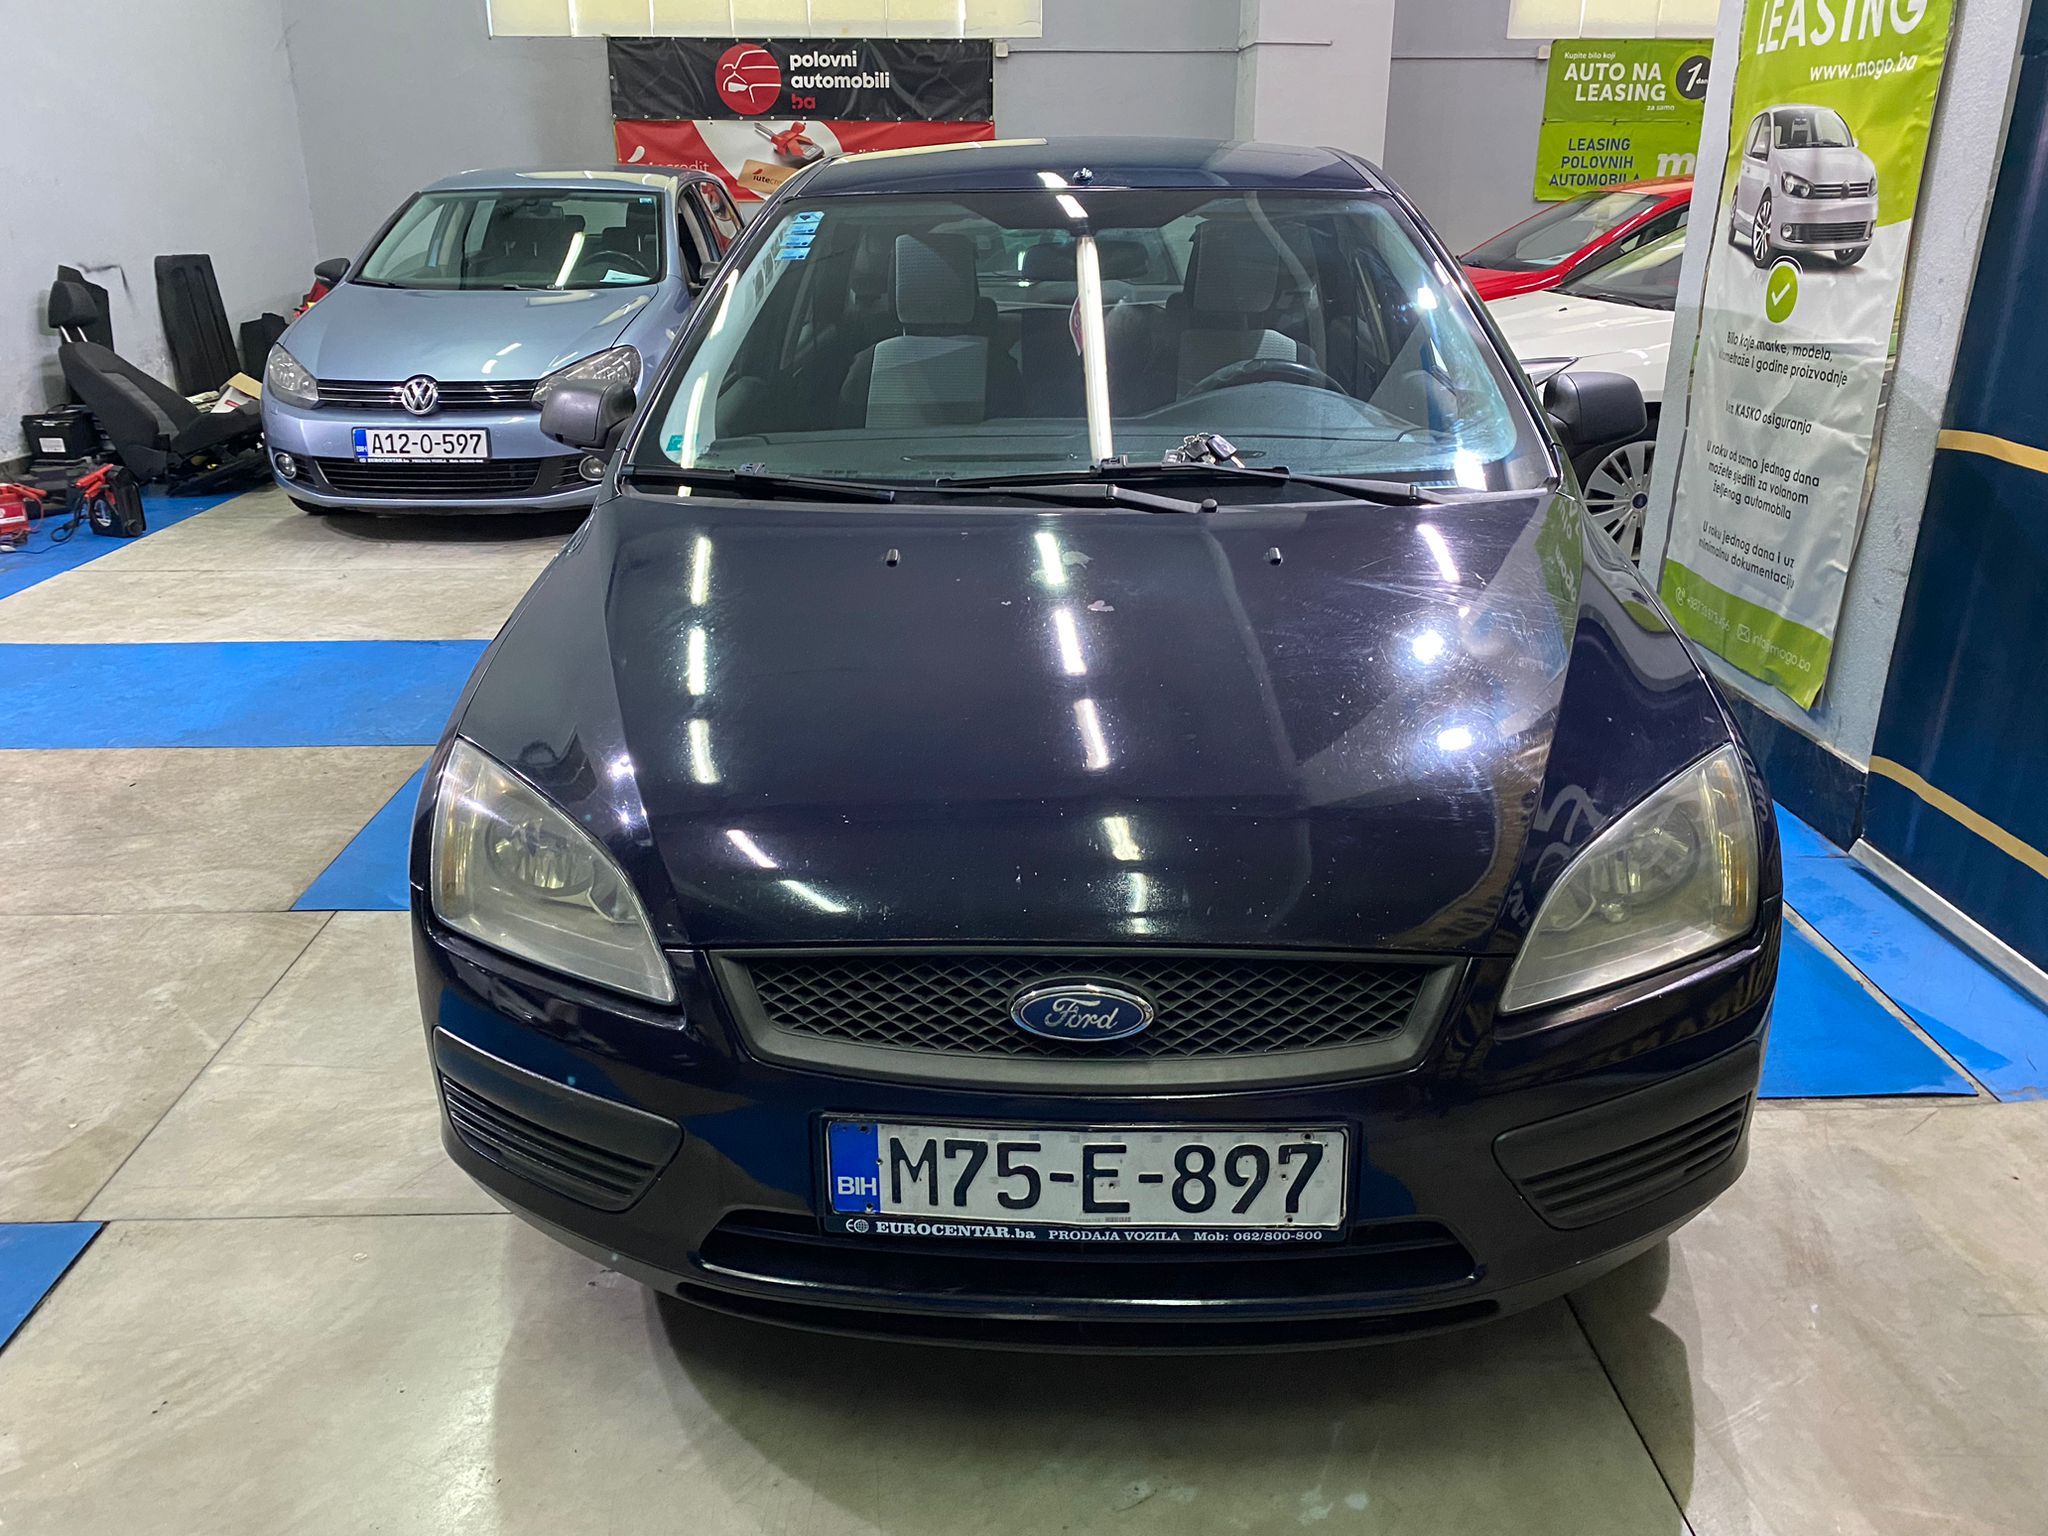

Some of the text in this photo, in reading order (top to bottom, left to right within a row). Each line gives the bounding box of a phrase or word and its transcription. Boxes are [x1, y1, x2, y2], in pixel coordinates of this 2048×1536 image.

[1756, 0, 1928, 54] LEASING
[789, 50, 857, 71] polovni
[1564, 52, 1617, 61] Kupite bilo koji
[1810, 50, 1918, 81] www.mogo.ba
[790, 72, 890, 89] automobili
[1564, 63, 1662, 81] AUTO NA
[1685, 62, 1703, 92] 1
[1575, 83, 1667, 102] LEASING
[1568, 138, 1631, 151] LEASING
[1560, 155, 1634, 169] POLOVNIH
[1740, 333, 1755, 351] koje
[1756, 340, 1790, 356] marke,
[1792, 344, 1833, 362] modela,
[1719, 349, 1750, 368] metraže
[1756, 359, 1789, 375] godine
[1790, 365, 1848, 388] proizvodnje
[1735, 403, 1762, 421] KASKO
[1762, 412, 1812, 436] osiguranja
[1706, 440, 1820, 487] U roku od samo jednog dana
[1708, 461, 1809, 505] možete sjediti za volanom
[1712, 479, 1792, 520] željenog automobila
[1702, 520, 1708, 532] U
[1708, 525, 1722, 540] roku
[1721, 529, 1751, 555] jednog
[1751, 544, 1775, 562] dana
[1783, 557, 1795, 569] uz
[1698, 537, 1795, 590] minimalnu dokumentaciju
[1044, 997, 1119, 1030] Ford
[837, 1176, 877, 1196] BIH
[889, 1137, 1324, 1214] M75-E-897
[875, 1221, 1323, 1242] EUROCENTAR.ba PRODAJA VOZILA Mob: 062/800-800
